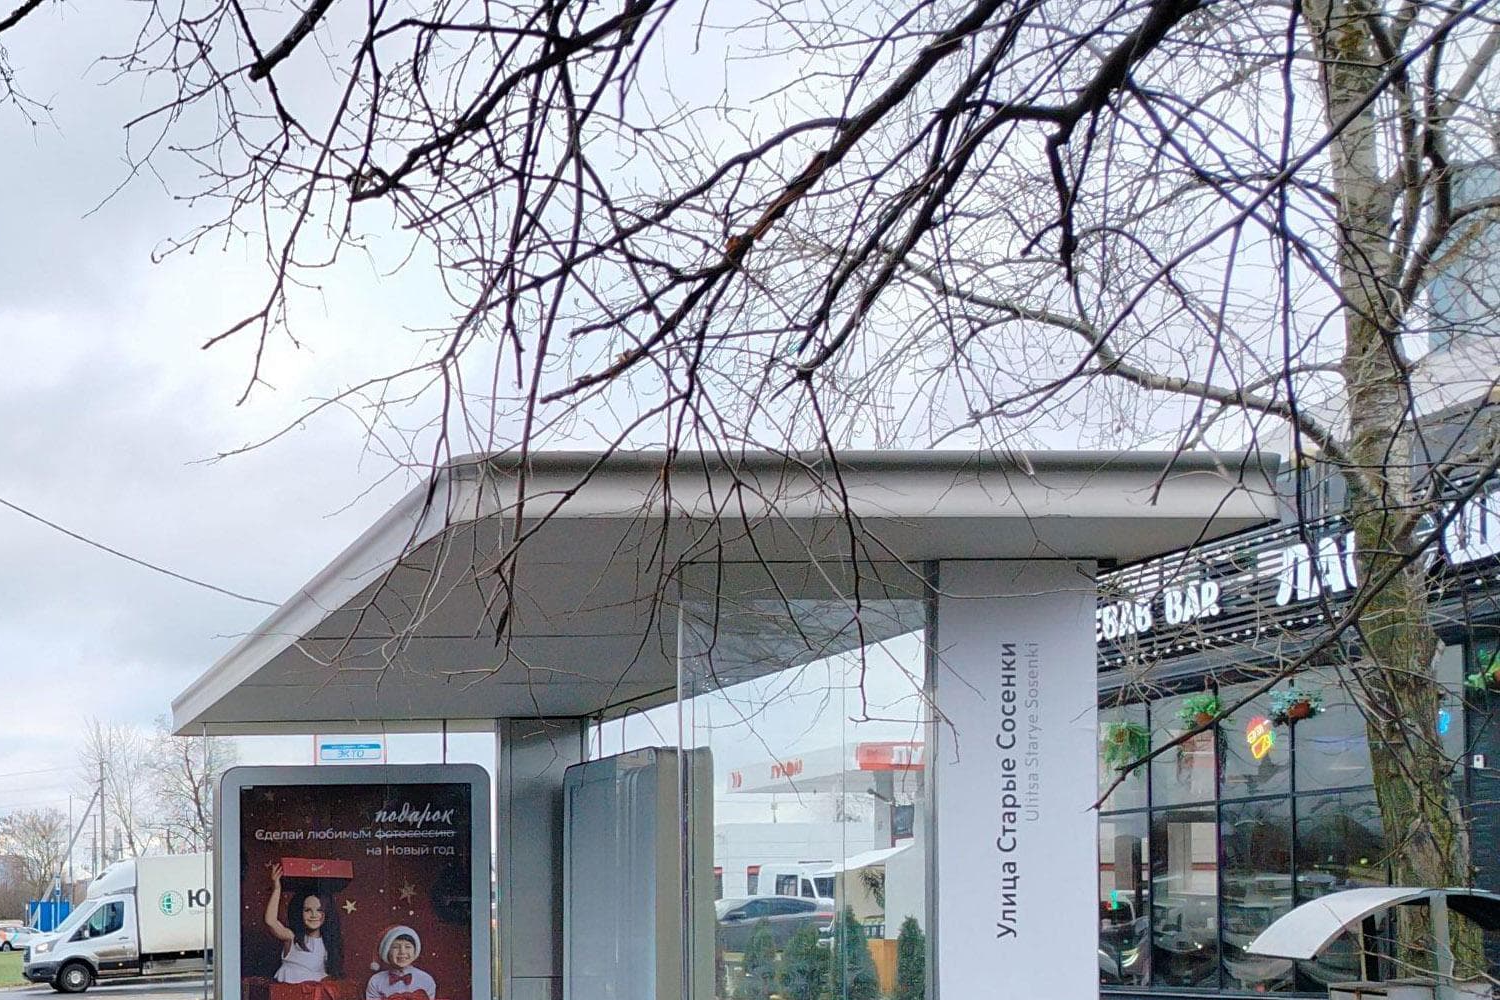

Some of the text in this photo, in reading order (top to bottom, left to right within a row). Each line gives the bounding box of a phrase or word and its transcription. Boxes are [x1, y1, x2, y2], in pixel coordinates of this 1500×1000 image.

[1164, 581, 1220, 625] BAR
[1024, 641, 1042, 822] Ulitsa Starye Sosenki
[996, 642, 1021, 938] Улица Старые Сосенки
[375, 802, 455, 828] подарок
[255, 828, 304, 842] Сделай
[307, 828, 371, 841] любимым
[366, 844, 455, 858] на Новый год
